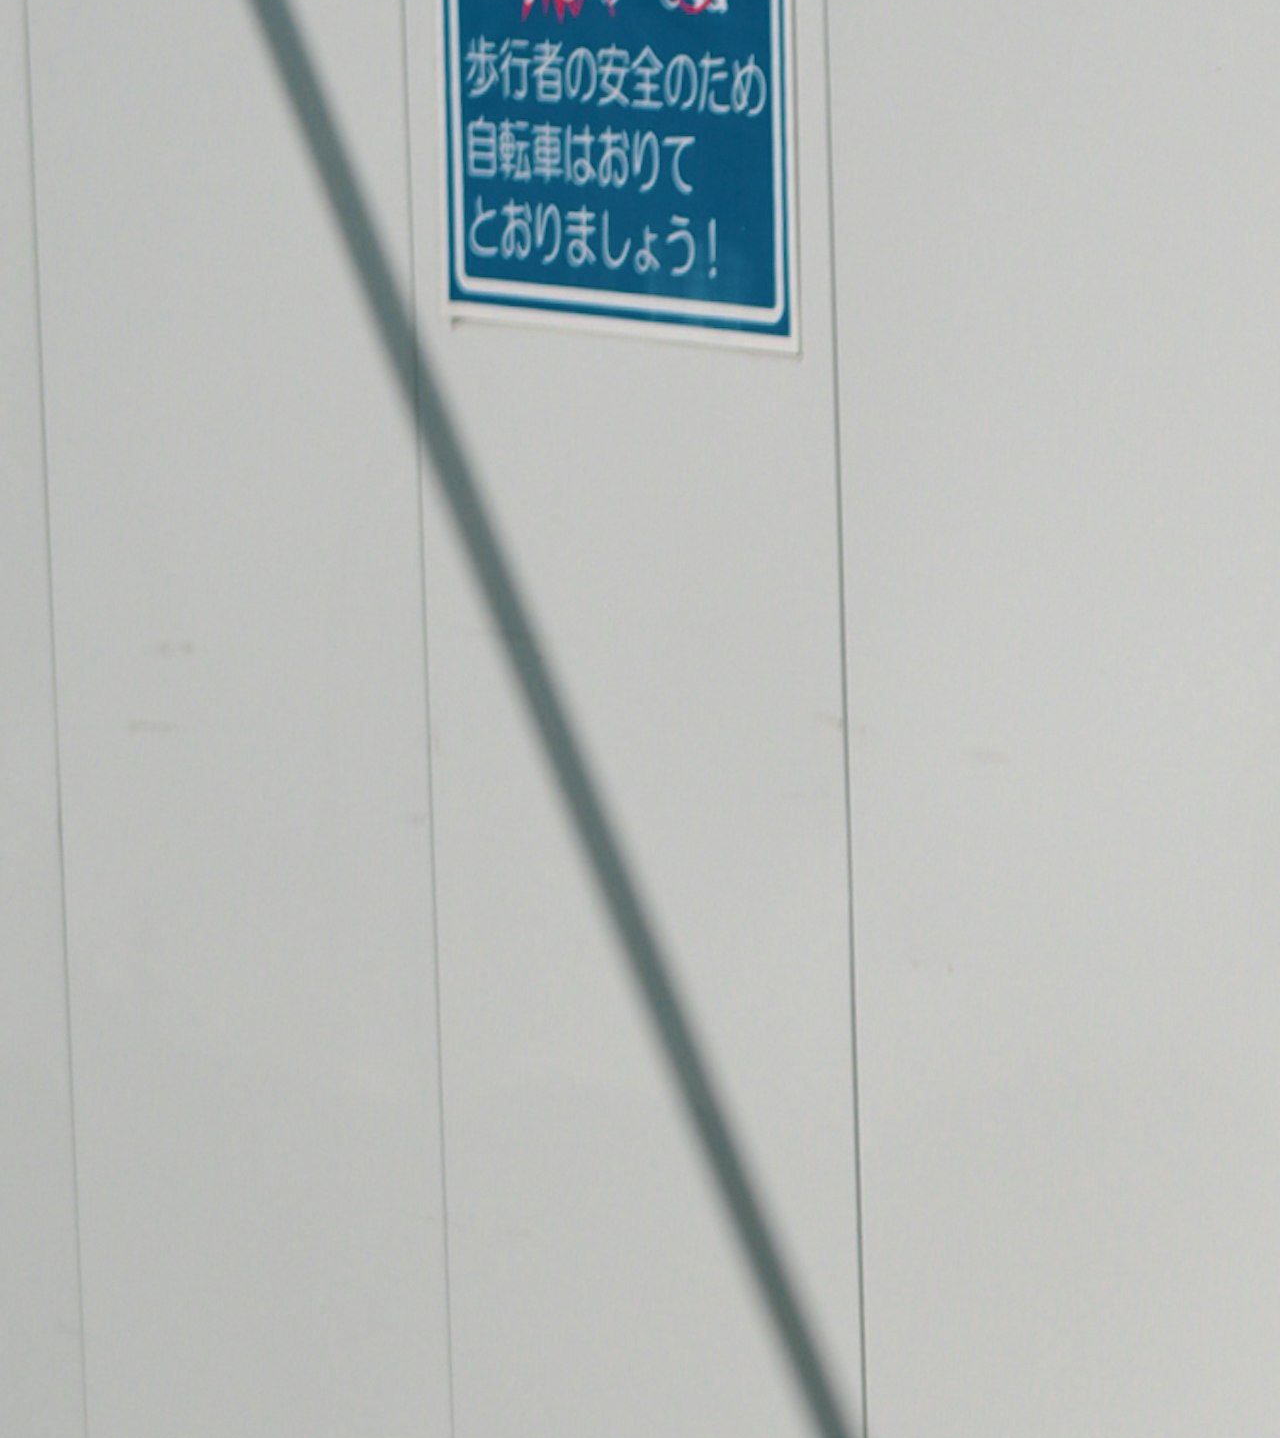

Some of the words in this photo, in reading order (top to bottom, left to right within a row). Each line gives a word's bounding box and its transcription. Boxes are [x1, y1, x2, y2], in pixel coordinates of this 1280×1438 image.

[466, 36, 767, 116] 歩行者の安全のため
[466, 117, 695, 193] 自転車はおりて
[470, 196, 717, 279] とおりましょう！
